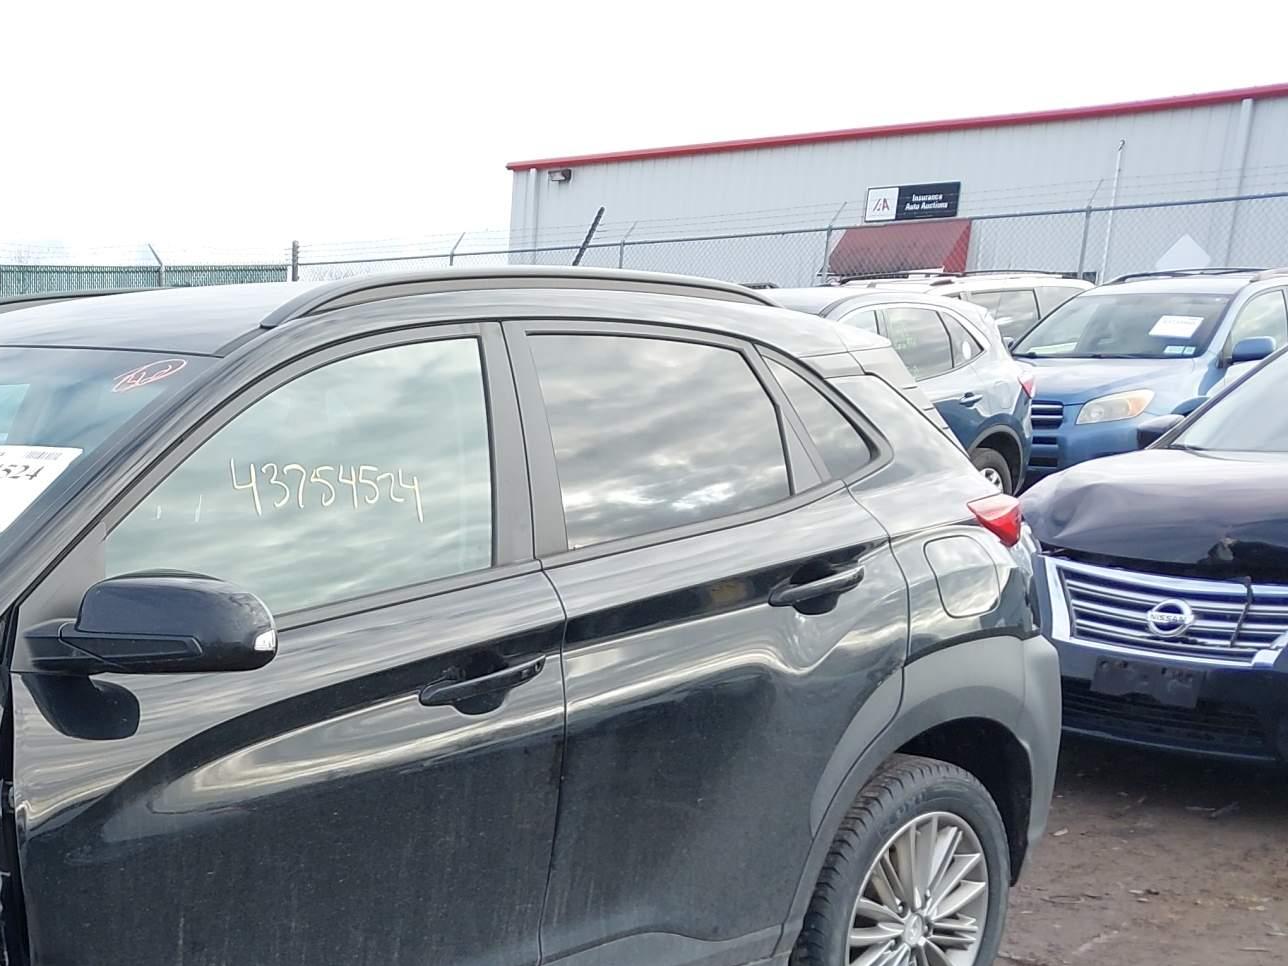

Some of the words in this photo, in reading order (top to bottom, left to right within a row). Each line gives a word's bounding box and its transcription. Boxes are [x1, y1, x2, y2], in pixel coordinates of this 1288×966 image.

[913, 194, 943, 202] Insurance
[906, 203, 920, 211] Auto
[922, 202, 948, 210] Auctions
[229, 457, 425, 523] 43754524
